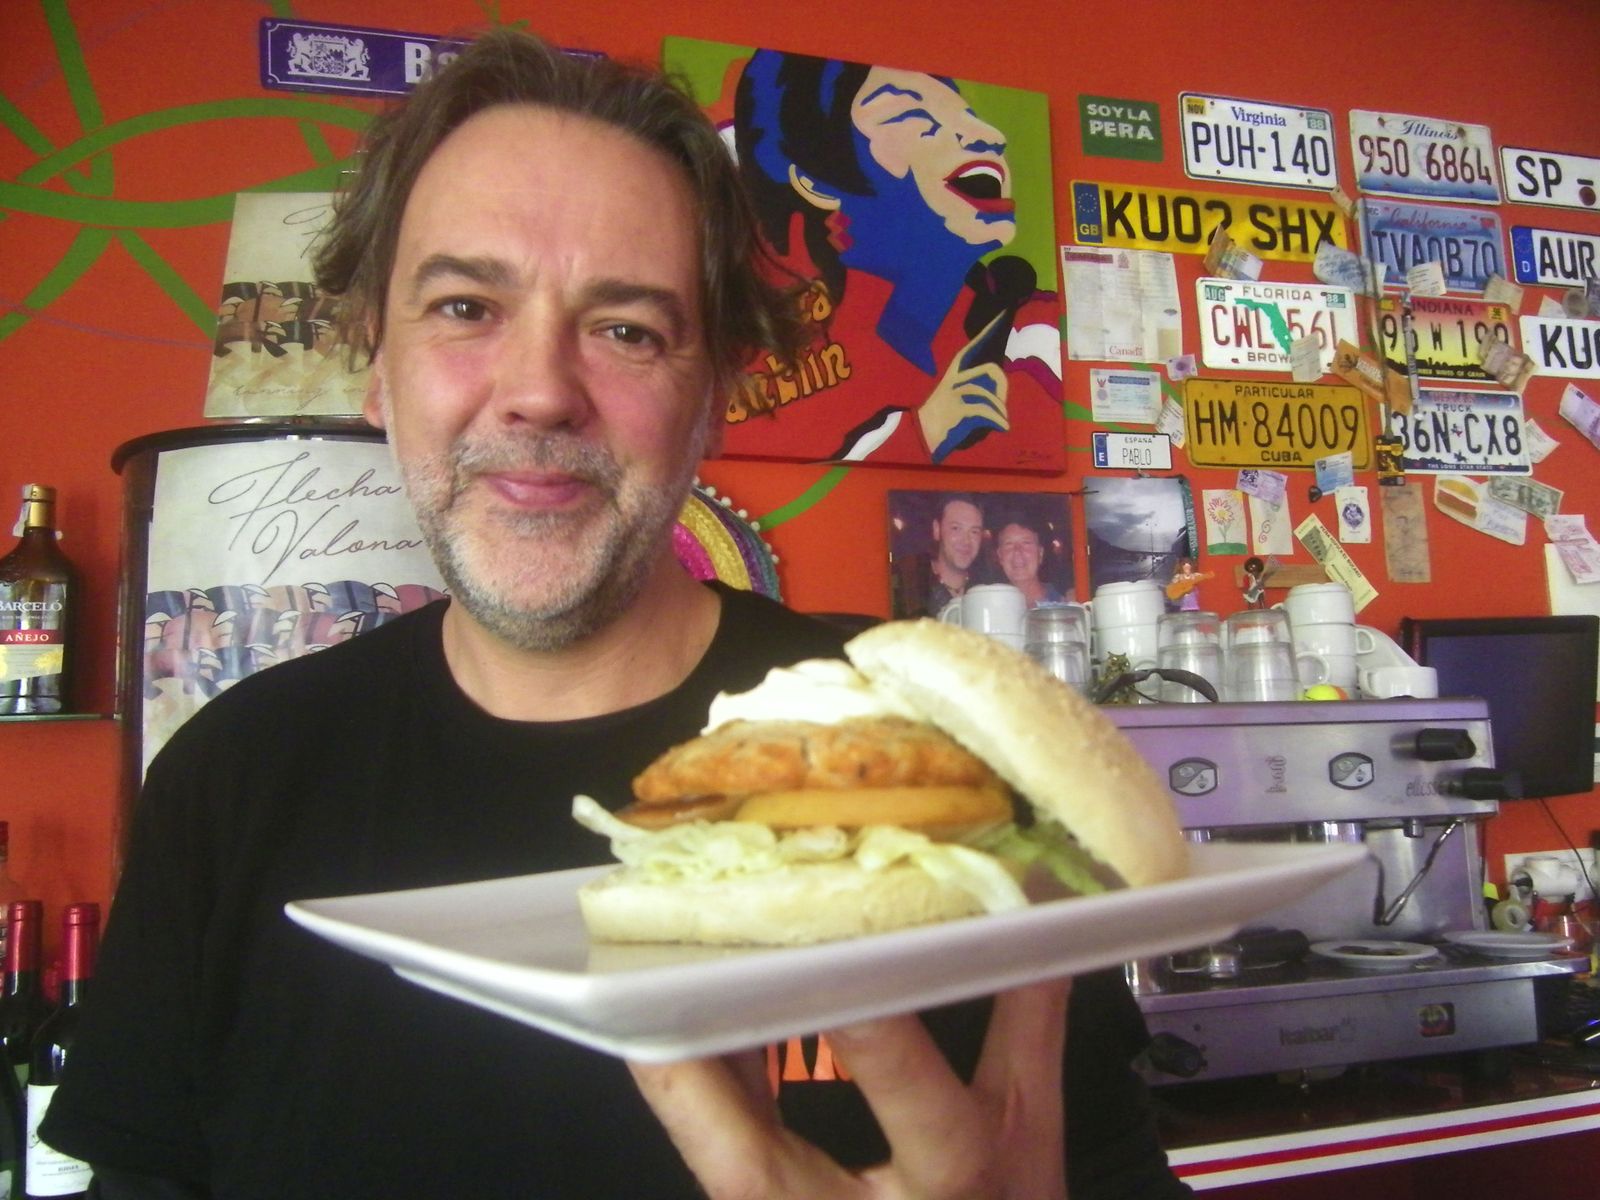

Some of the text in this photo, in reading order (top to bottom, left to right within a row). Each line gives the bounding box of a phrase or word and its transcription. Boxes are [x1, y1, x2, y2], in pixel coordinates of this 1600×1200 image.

[1086, 103, 1152, 122] SOY LA
[1187, 104, 1205, 115] NOV
[1230, 106, 1287, 127] Virginia
[1088, 119, 1154, 140] PERA
[1401, 119, 1458, 140] Illinois
[1191, 121, 1331, 177] PUH-140
[1358, 134, 1492, 186] 950 6864
[1079, 223, 1099, 237] GB
[1248, 204, 1337, 255] SHX
[1521, 260, 1531, 273] D
[1204, 286, 1226, 302] AUG
[1242, 286, 1313, 301] FLORIDA
[1411, 300, 1474, 315] INDIANA
[1211, 304, 1275, 350] CWL
[1234, 385, 1315, 399] PARTICULAR
[1436, 403, 1473, 413] TRUCK
[1098, 452, 1105, 462] E
[1122, 447, 1152, 466] PABLO
[1260, 451, 1303, 463] CUBA
[208, 451, 402, 551] Flecha
[251, 504, 424, 585] Valona
[6, 632, 50, 642] AÑEJO
